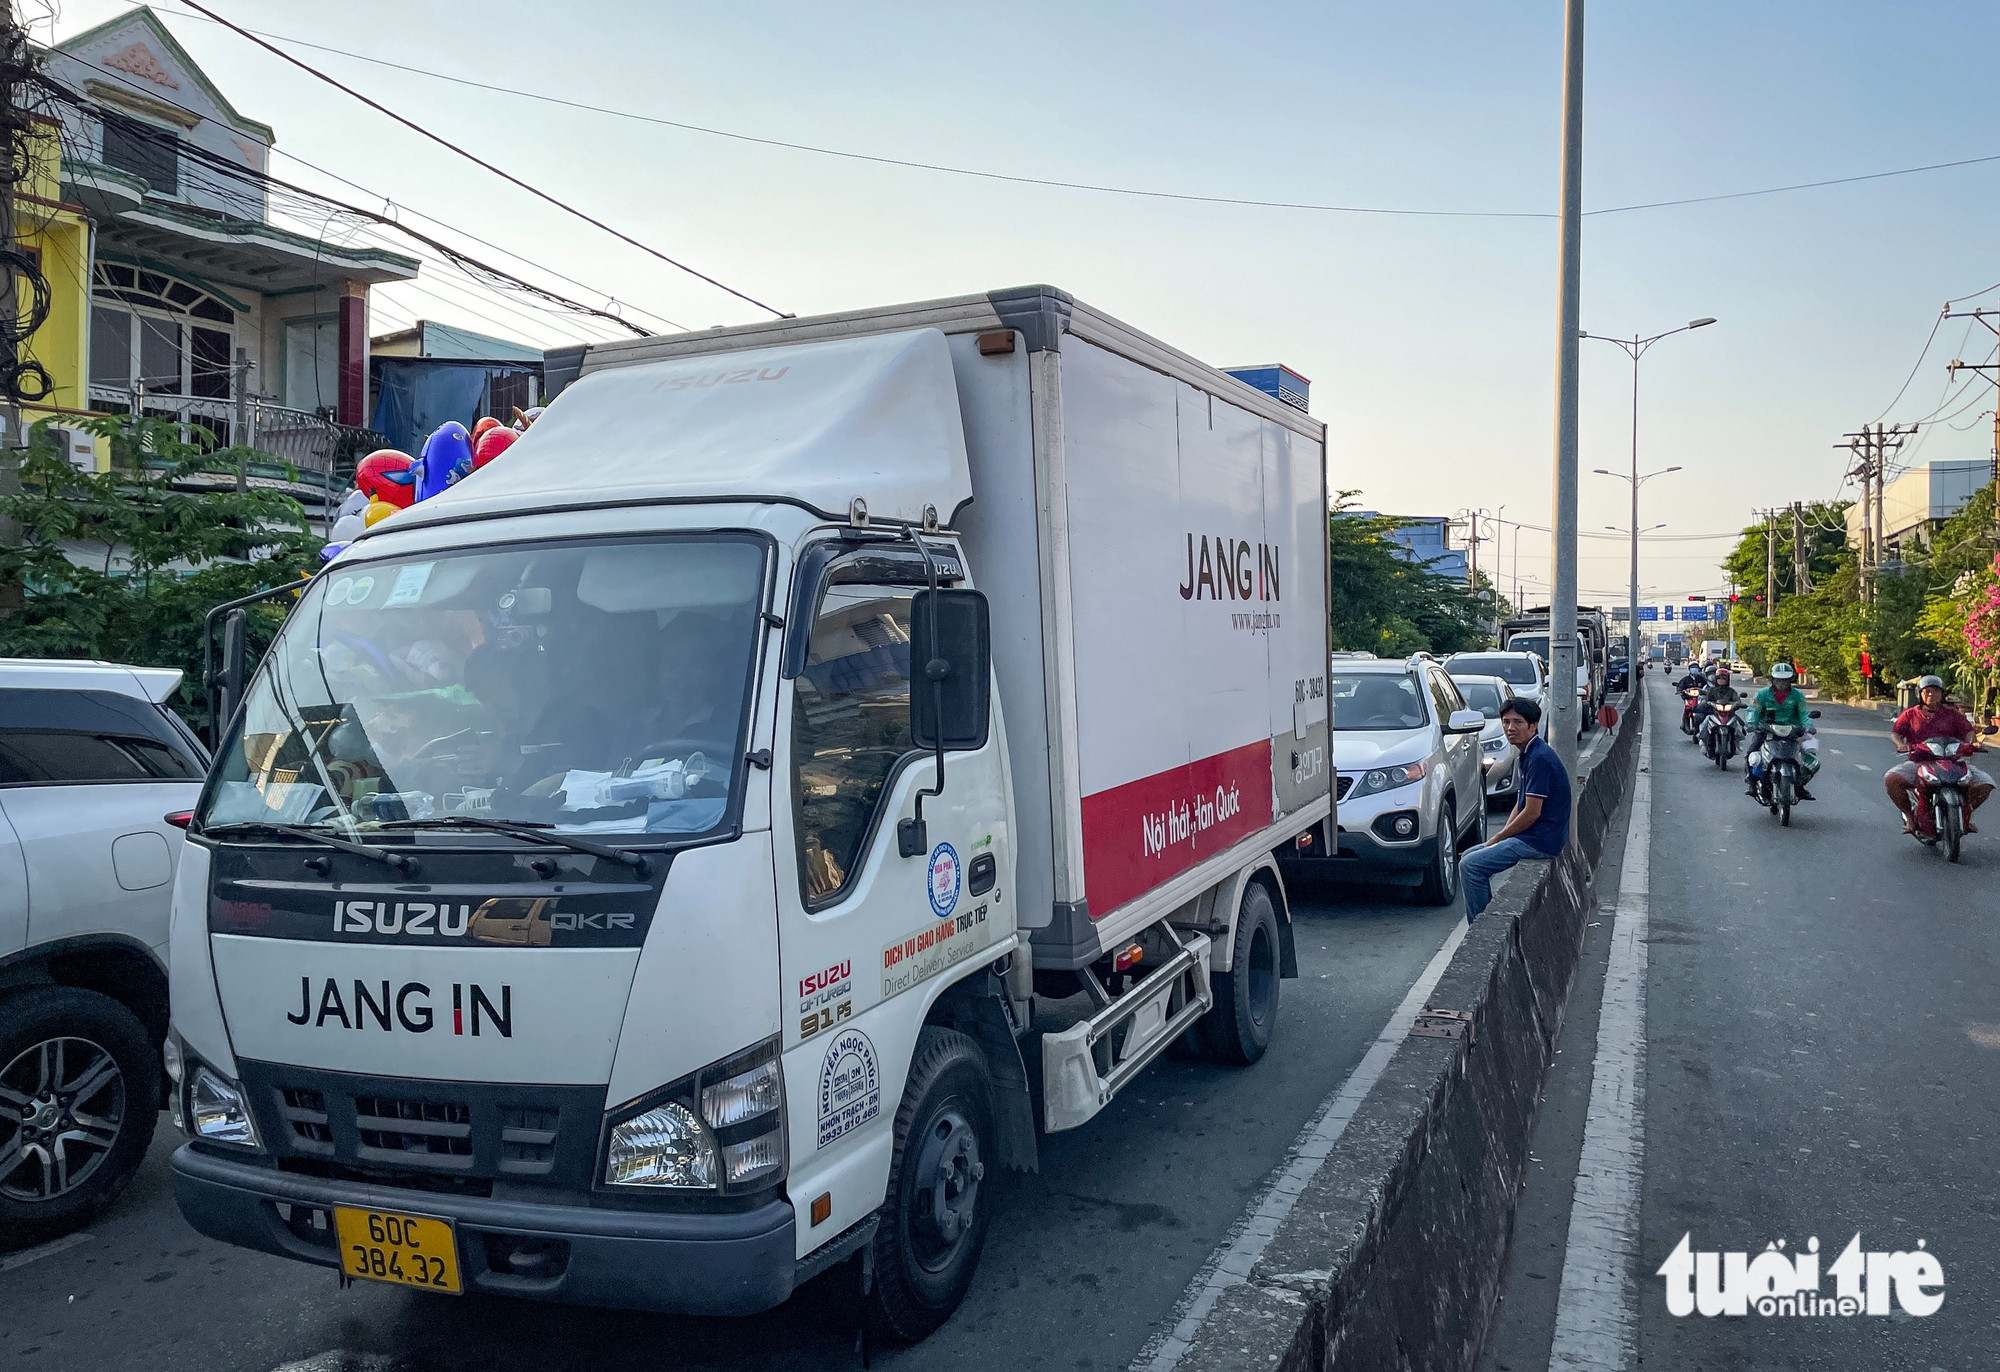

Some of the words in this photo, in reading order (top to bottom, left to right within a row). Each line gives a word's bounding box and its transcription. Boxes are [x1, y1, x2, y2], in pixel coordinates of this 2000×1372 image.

[650, 366, 790, 394] ISUZU
[1180, 533, 1252, 600] JANG
[1258, 543, 1280, 601] IN
[1231, 610, 1280, 636] www.jangin.vn
[1143, 813, 1166, 859] Nội
[1169, 799, 1190, 845] thất
[1216, 779, 1240, 822] Quốc
[333, 900, 470, 937] ISUZU
[551, 913, 635, 931] QKR
[885, 944, 903, 970] DỊCH
[905, 938, 915, 960] VỤ
[917, 929, 934, 953] GIAO
[956, 911, 973, 933] TRỤC
[975, 901, 988, 925] TIẾP
[799, 960, 851, 998] ISUZU
[885, 971, 910, 996] Direct
[912, 958, 944, 982] Delivery
[947, 941, 974, 964] Service
[287, 976, 434, 1034] JANG
[452, 983, 513, 1038] IN
[800, 981, 851, 1013] DI-TURBO
[800, 1007, 834, 1039] 91
[837, 1000, 851, 1021] PS
[840, 1037, 864, 1055] NGỌC
[851, 1066, 861, 1079] 3N
[820, 1126, 842, 1144] 0933
[844, 1115, 860, 1130] 810
[862, 1105, 878, 1119] 469
[842, 1101, 864, 1120] TRẠCH
[368, 1214, 420, 1248] 60C
[352, 1245, 448, 1287] 384.32
